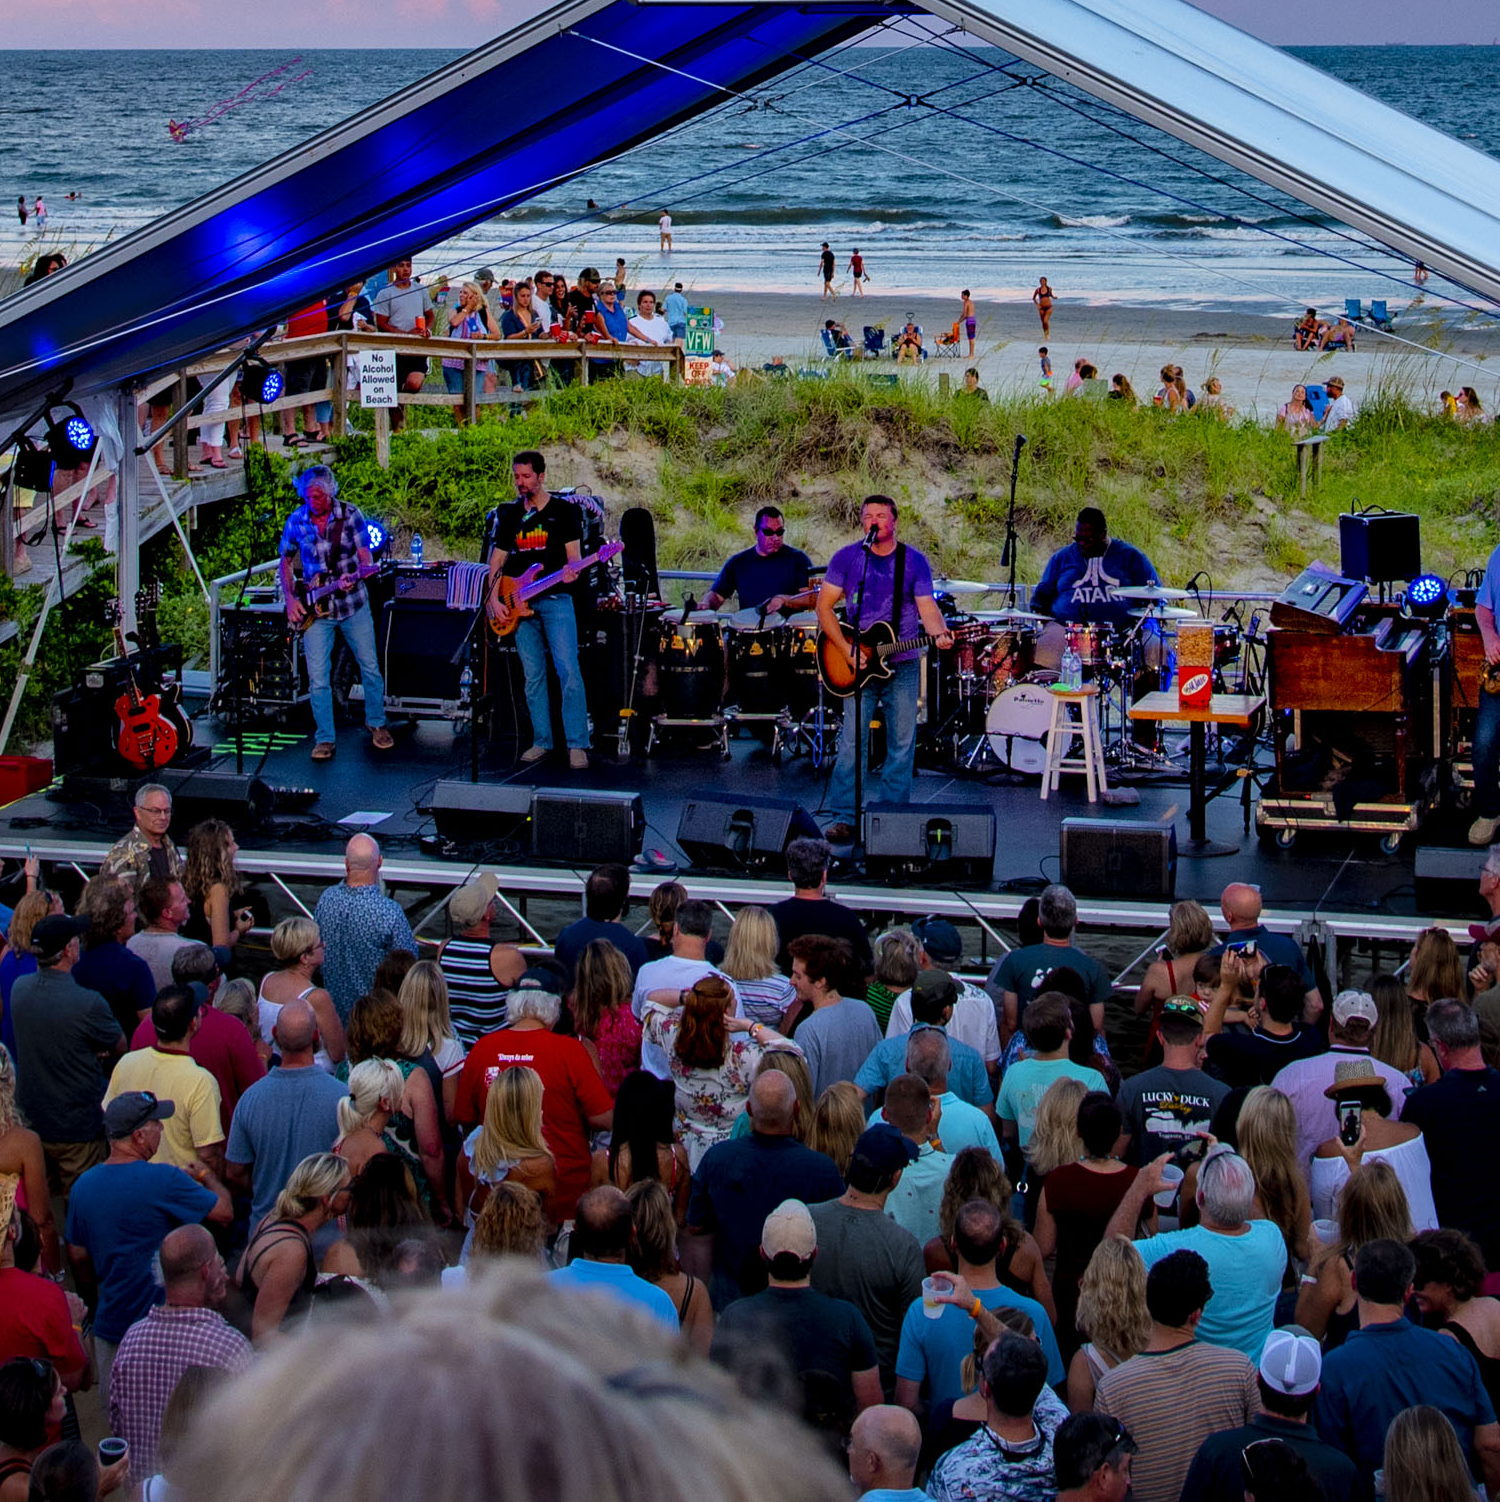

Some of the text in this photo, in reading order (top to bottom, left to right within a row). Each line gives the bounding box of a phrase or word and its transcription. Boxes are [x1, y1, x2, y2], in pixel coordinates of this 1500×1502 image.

[687, 331, 711, 350] VFW
[371, 354, 384, 362] No
[362, 364, 394, 373] Alcohol
[689, 362, 709, 370] KEEP
[691, 369, 707, 378] OFF
[362, 375, 395, 384] Allowed
[373, 386, 384, 394] on
[366, 395, 392, 404] Beach
[1142, 1091, 1210, 1107] LUCKY DUCK
